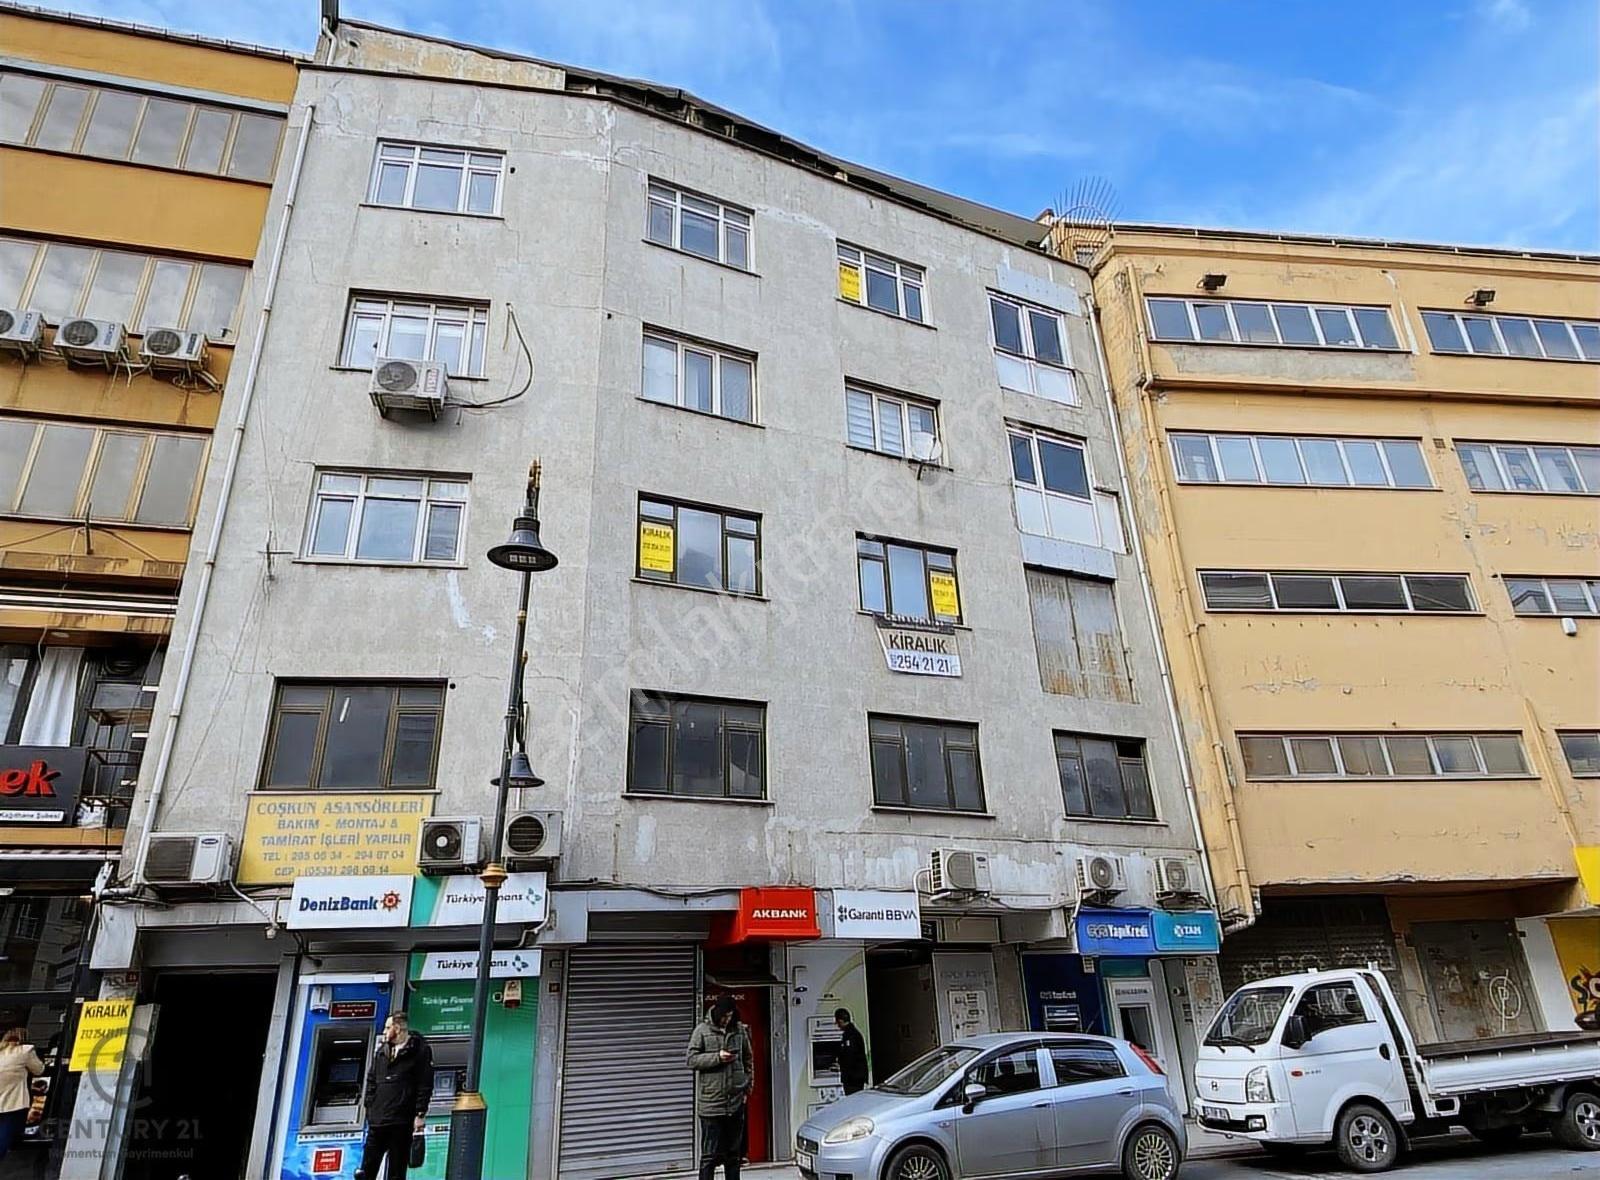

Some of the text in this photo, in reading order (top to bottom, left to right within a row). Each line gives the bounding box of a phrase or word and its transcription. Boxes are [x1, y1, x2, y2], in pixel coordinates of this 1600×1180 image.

[889, 632, 947, 654] KİRALIK
[897, 654, 919, 670] 254
[922, 657, 934, 672] 21
[937, 659, 949, 673] 21
[0, 759, 61, 795] ek
[257, 798, 424, 817] COŞKUN ASANSÖRLERİ
[278, 819, 319, 830] BAKIM
[335, 818, 387, 830] MONTAJ
[261, 832, 411, 847] TAMİRAT İŞLERİ YAPILIR
[264, 852, 280, 861] TEL
[274, 867, 294, 876] CEP
[299, 896, 378, 911] DenizBank
[445, 893, 523, 905] Türkiye nans
[752, 909, 808, 919] AKBANK
[849, 909, 917, 921] Garanti BBVA
[437, 960, 474, 970] Türkiye
